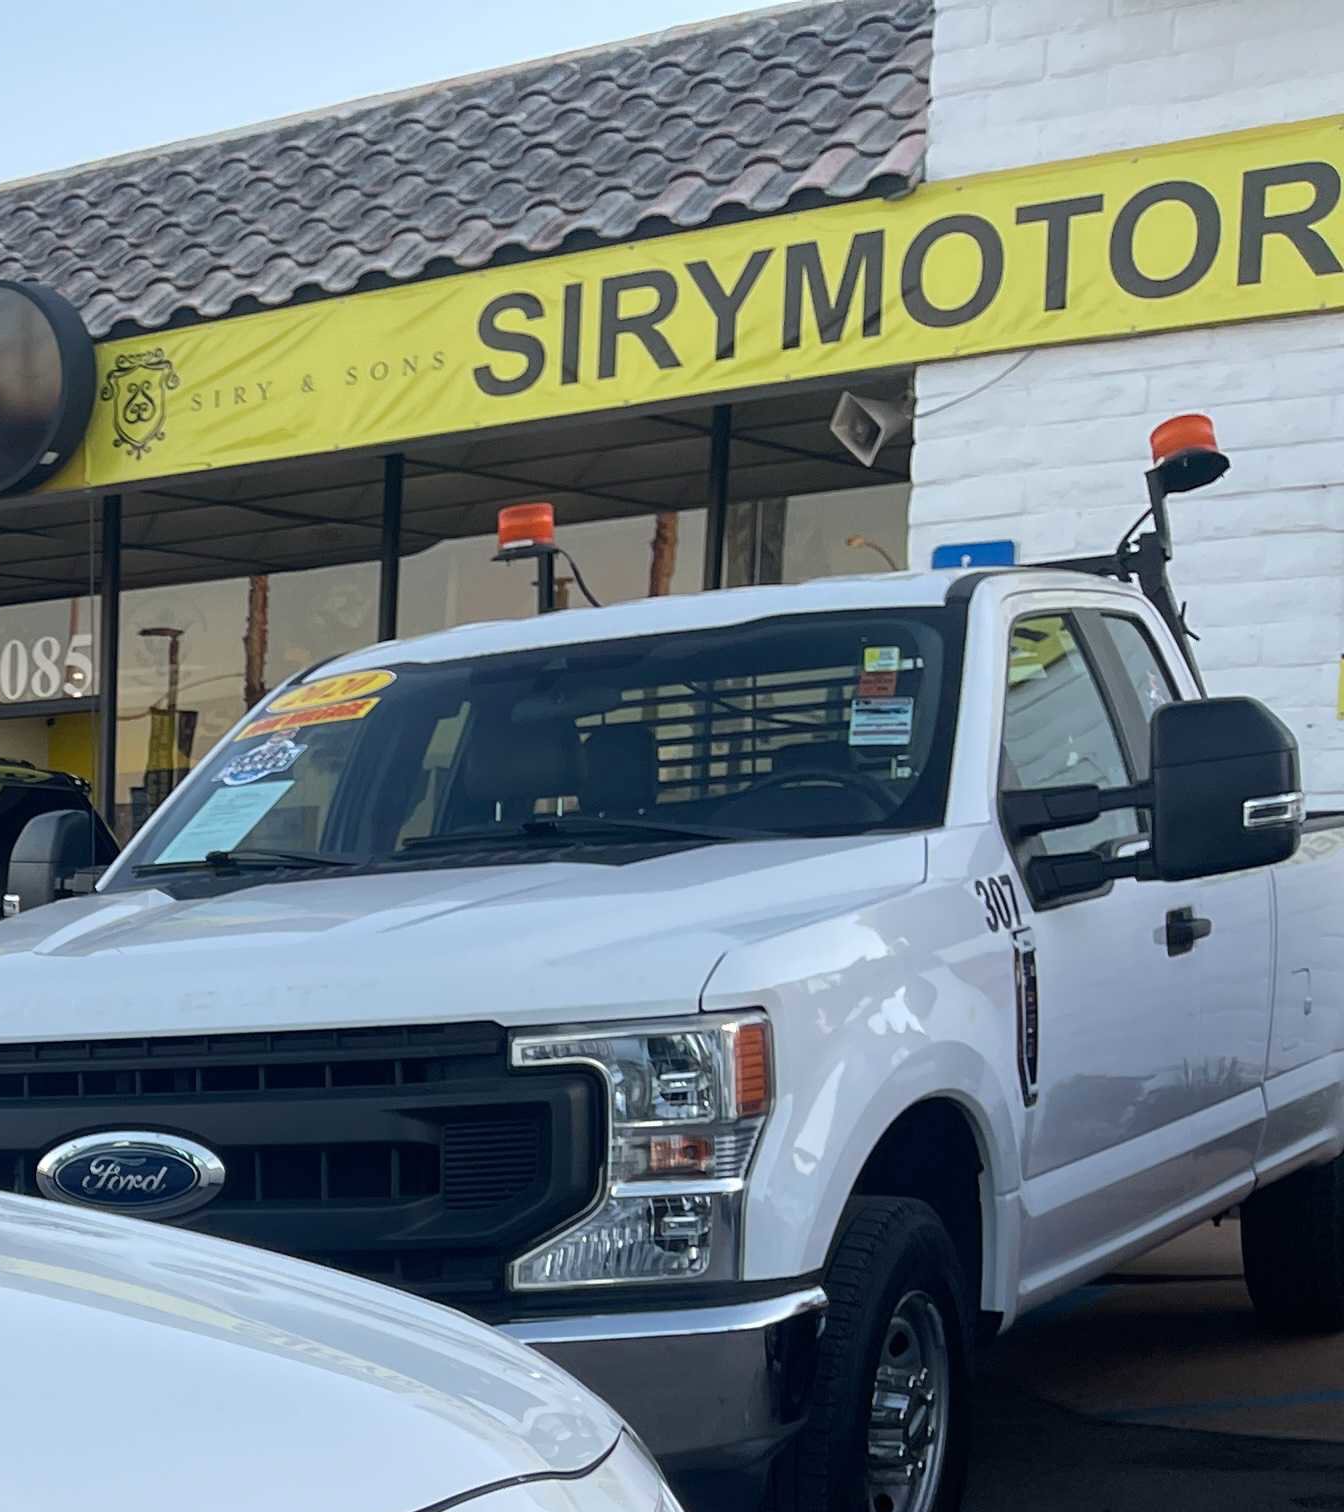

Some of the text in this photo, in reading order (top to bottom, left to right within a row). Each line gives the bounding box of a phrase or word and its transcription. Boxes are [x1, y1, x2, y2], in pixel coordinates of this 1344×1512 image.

[190, 351, 446, 412] SIRY & SONS
[975, 873, 1022, 933] 307
[81, 1156, 168, 1194] Ford
